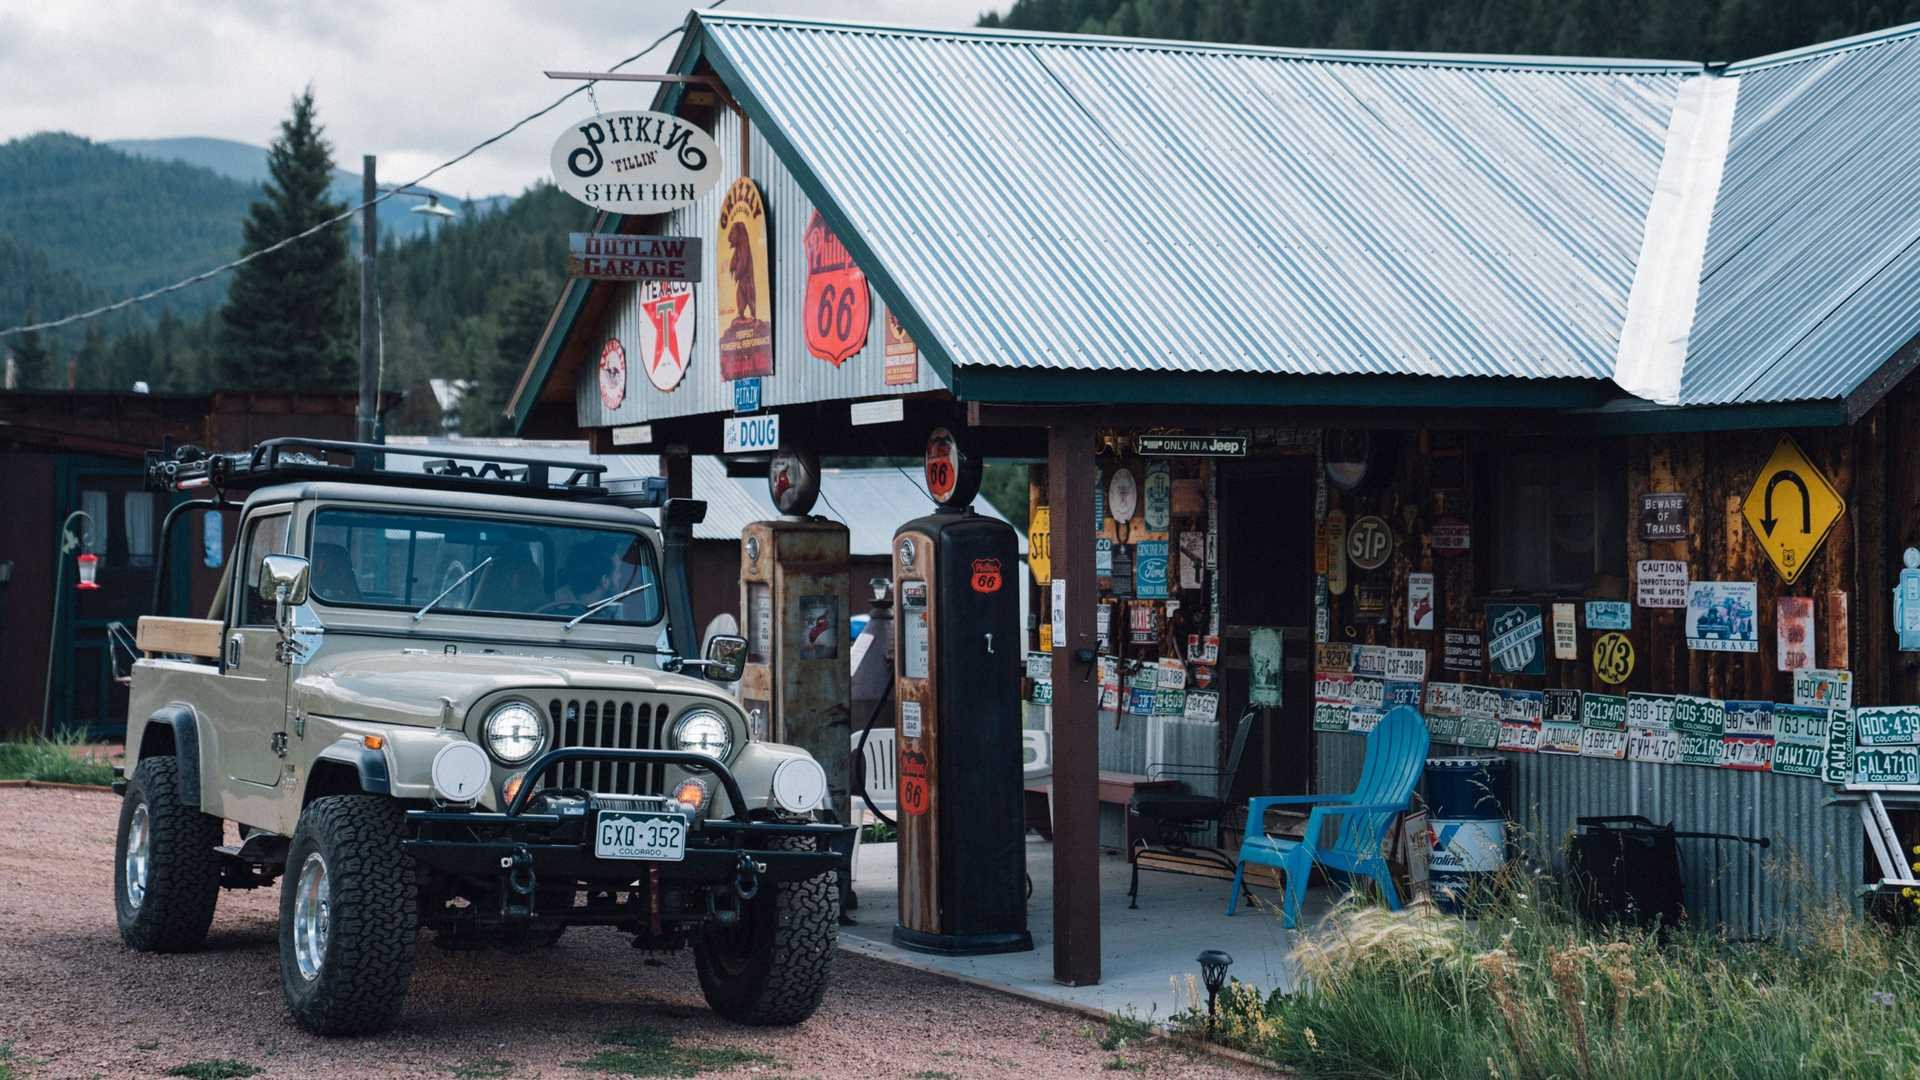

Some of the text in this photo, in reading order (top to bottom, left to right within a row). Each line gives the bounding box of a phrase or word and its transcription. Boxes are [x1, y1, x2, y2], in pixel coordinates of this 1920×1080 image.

[568, 116, 707, 177] PITKIN
[585, 184, 695, 201] STATION
[585, 238, 686, 258] OUTLAW
[584, 260, 685, 278] GARAGE
[645, 280, 688, 298] TEXACO
[817, 284, 855, 341] 66
[741, 419, 775, 446] DOUG
[1163, 439, 1239, 454] ONLY IN A Jeep
[931, 463, 947, 486] 66
[1645, 499, 1683, 510] BEWARE
[1657, 512, 1670, 522] OF
[1352, 523, 1386, 560] STP
[1641, 563, 1683, 574] CAUTION
[978, 574, 995, 588] 66
[1659, 589, 1685, 598] SHAFTS
[1598, 634, 1630, 676] 273
[1556, 696, 1577, 717] 1584
[1584, 701, 1626, 722] 82134RS
[1726, 712, 1772, 730] 987 VMH
[1874, 735, 1912, 743] COLORADO
[1724, 743, 1744, 760] 147
[1776, 746, 1824, 767] GAW170
[1856, 755, 1915, 774] GAL4710
[1870, 774, 1907, 782] COLORADO
[905, 781, 922, 808] 66
[618, 848, 662, 856] COLORADO
